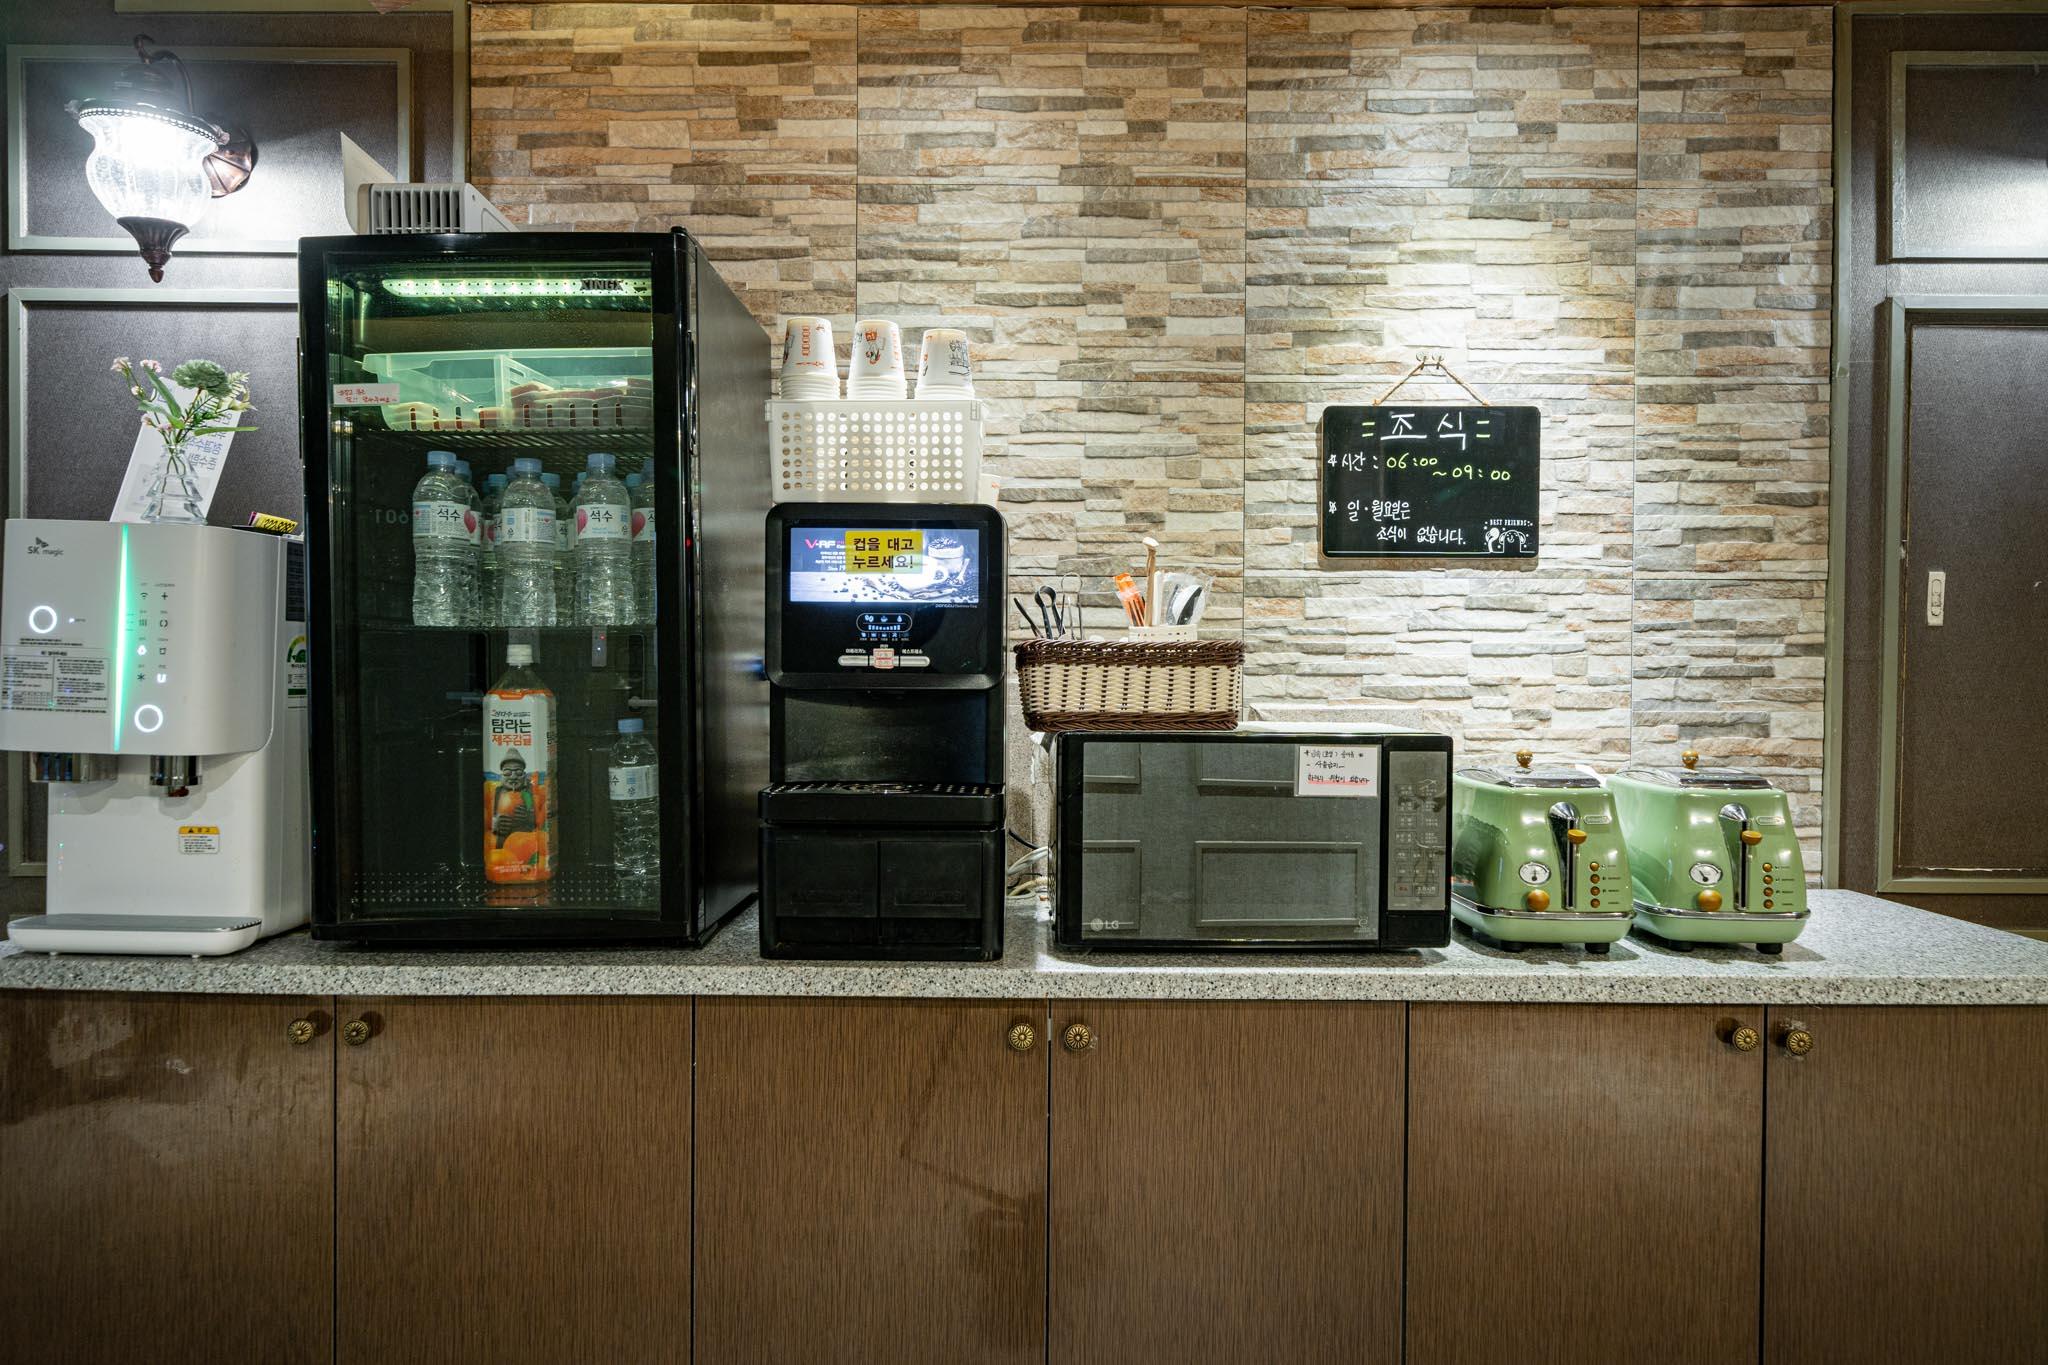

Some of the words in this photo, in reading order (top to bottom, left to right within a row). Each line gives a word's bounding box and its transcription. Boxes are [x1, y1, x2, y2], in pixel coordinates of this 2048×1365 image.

[1386, 452, 1438, 469] 06:00
[437, 508, 461, 521] 석수
[590, 510, 613, 522] 석수
[1376, 526, 1407, 543] 조식이
[853, 537, 880, 551] 컵을
[888, 537, 914, 551] 대고
[27, 545, 40, 555] SK
[42, 549, 64, 557] magic
[853, 555, 913, 569] 누르세요!
[491, 718, 532, 734] 탐라는
[491, 734, 532, 747] 제주감귤
[1105, 920, 1119, 930] LG
